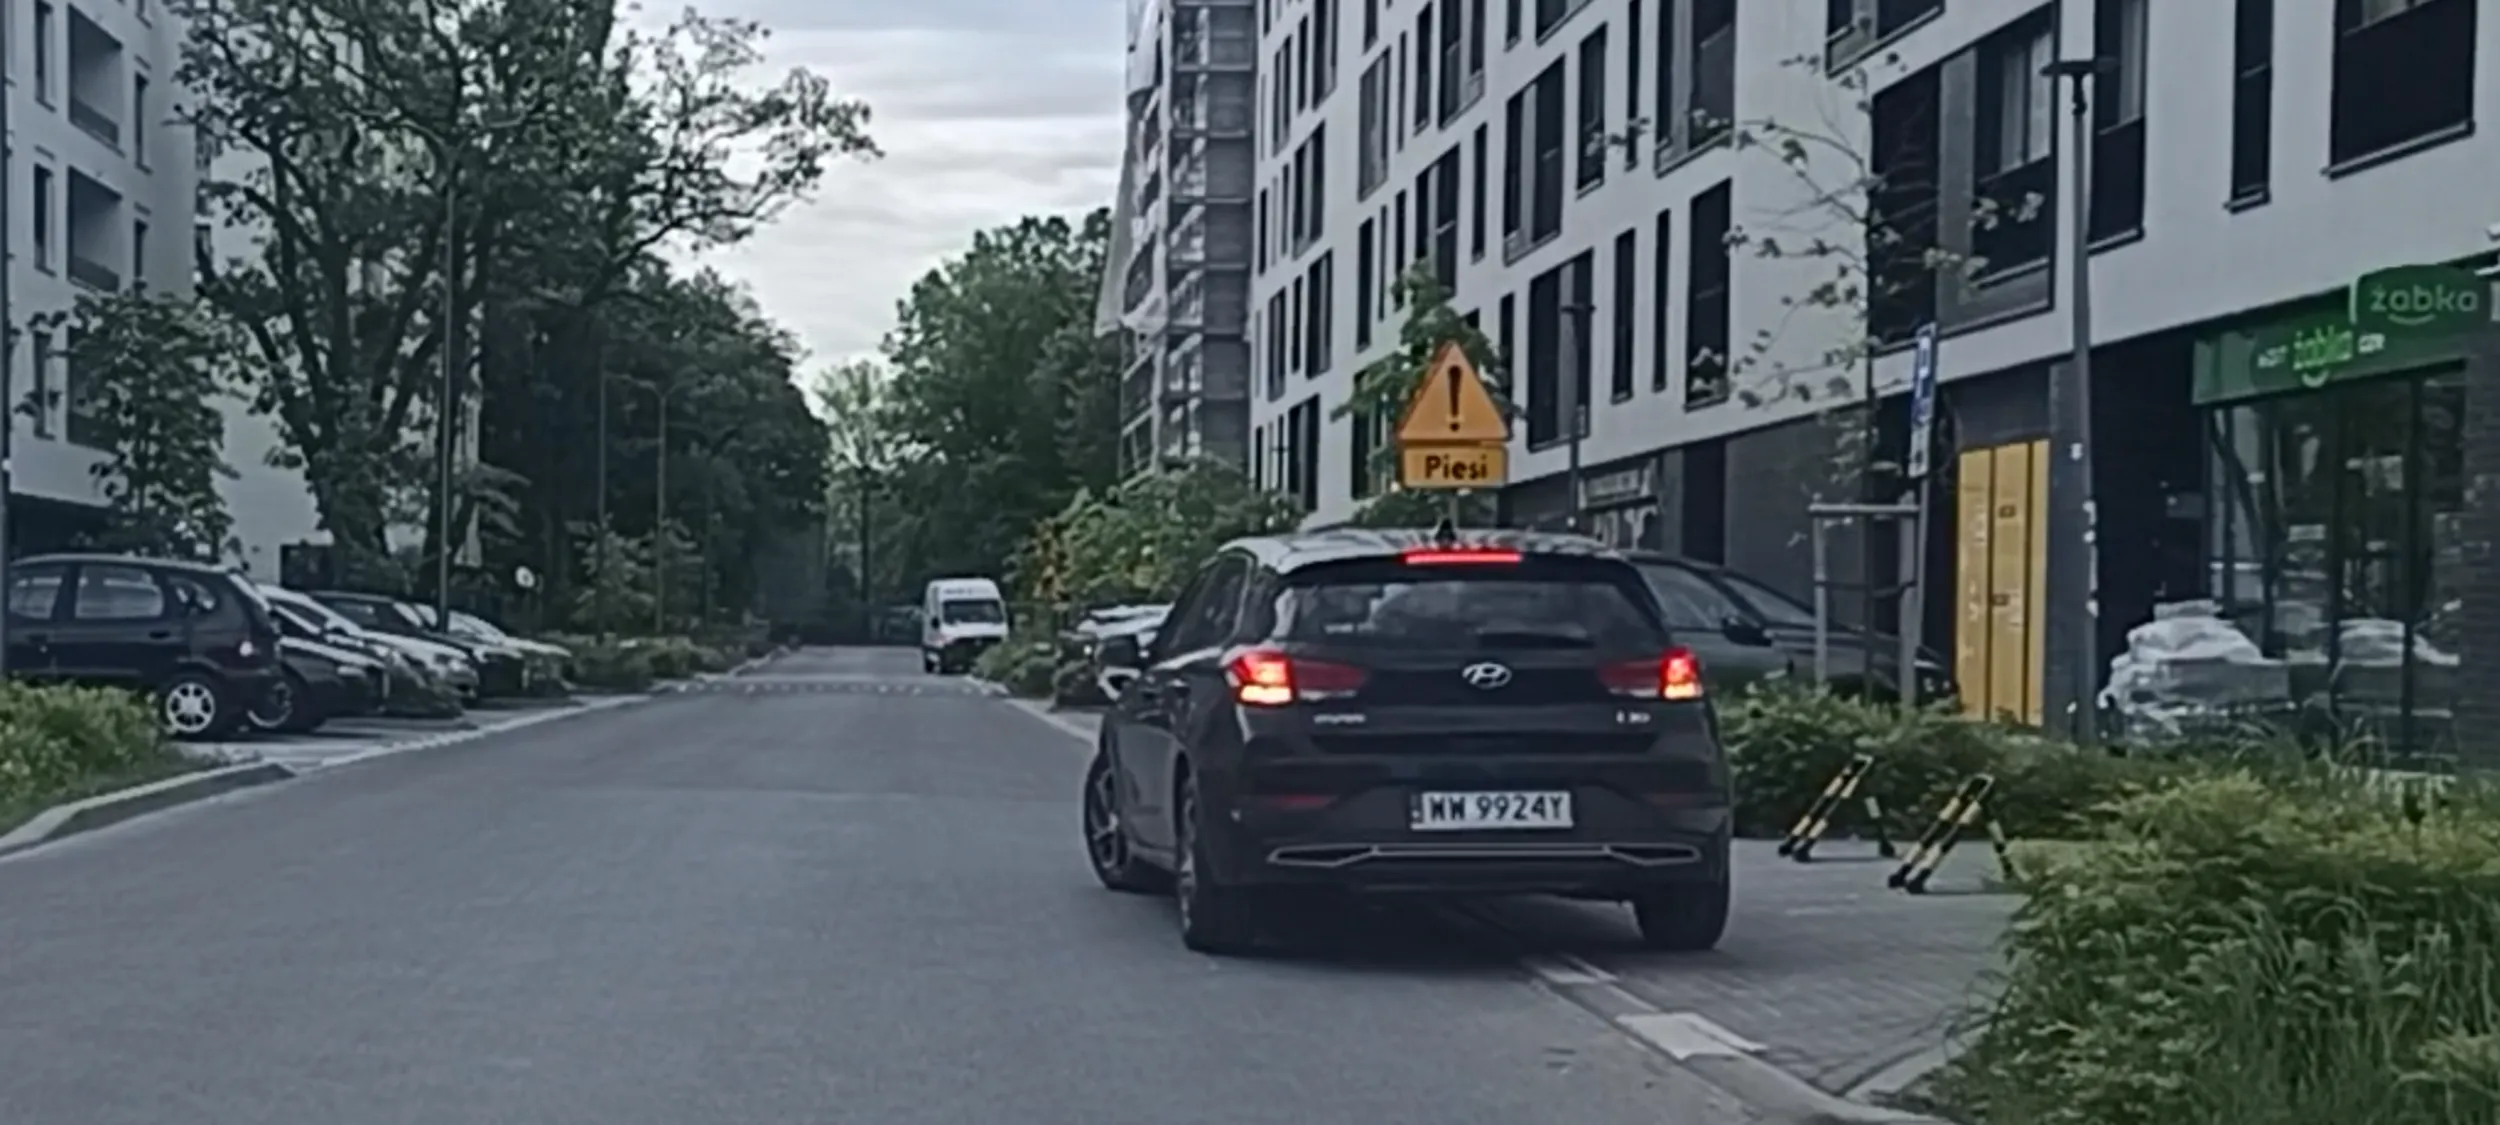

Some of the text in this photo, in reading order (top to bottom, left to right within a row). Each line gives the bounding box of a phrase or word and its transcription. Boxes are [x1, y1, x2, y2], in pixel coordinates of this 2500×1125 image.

[2370, 283, 2478, 313] żabka
[1424, 454, 1488, 479] Piesi
[1430, 795, 1563, 820] WW 9924Y
